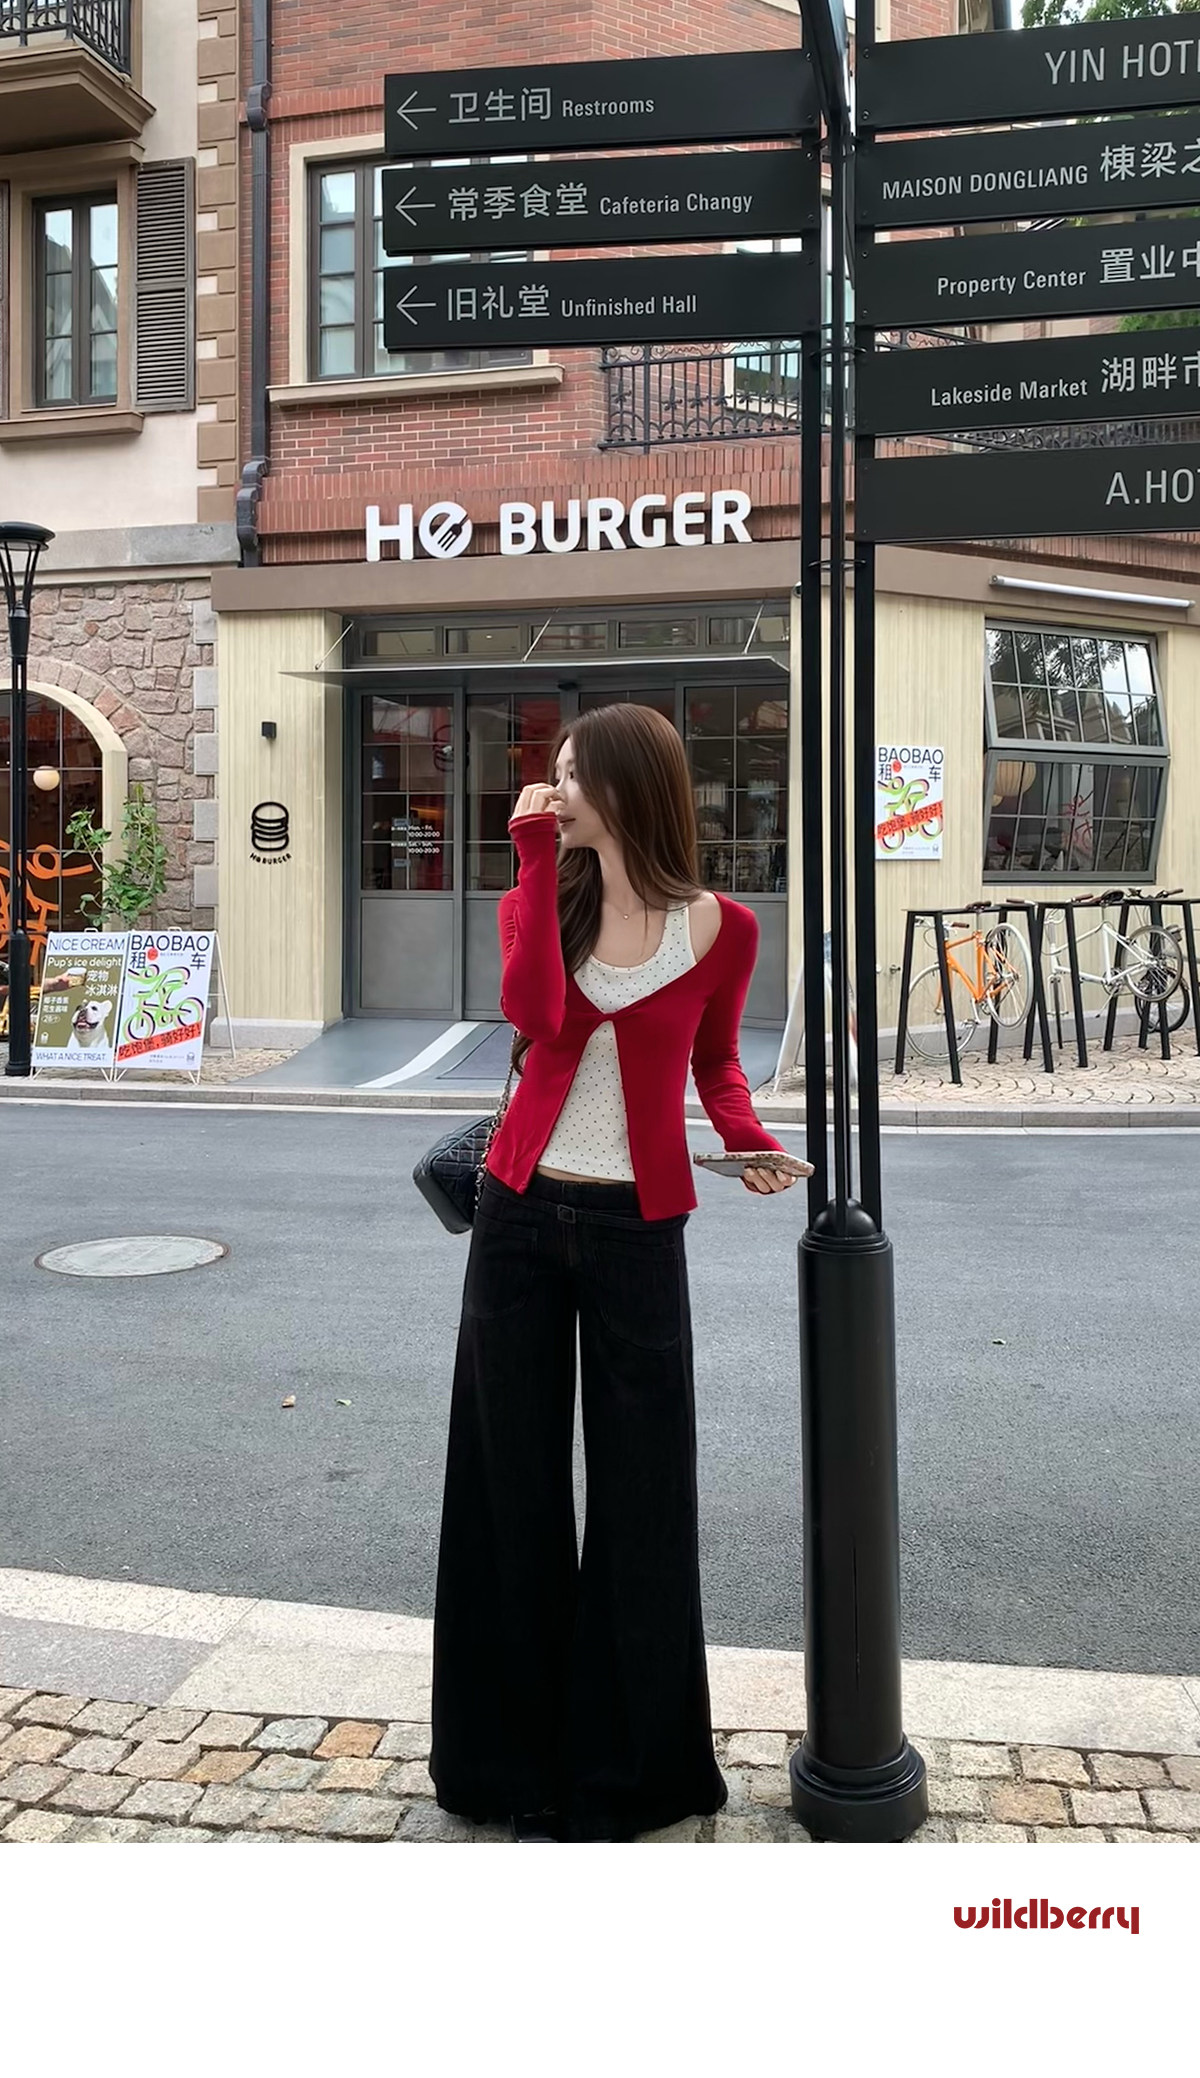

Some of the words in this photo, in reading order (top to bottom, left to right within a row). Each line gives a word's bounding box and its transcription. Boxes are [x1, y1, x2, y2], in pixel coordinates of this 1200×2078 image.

[1044, 47, 1105, 85] YIN
[1122, 39, 1200, 79] HOT
[447, 87, 552, 124] 卫生间
[562, 98, 654, 118] Restrooms
[882, 176, 962, 200] MAISON
[970, 165, 1088, 193] DONGLIANG
[447, 182, 589, 221] 常季食堂
[600, 194, 680, 215] Cafeteria
[686, 193, 753, 214] Changy
[937, 274, 1017, 297] Property
[1023, 270, 1086, 290] Center
[447, 283, 550, 322] 旧礼堂
[561, 297, 655, 318] Unfinished
[662, 294, 697, 314] Hall
[931, 383, 1012, 406] Lakeside
[1019, 379, 1088, 400] Market
[1105, 468, 1200, 505] A.HO
[499, 490, 752, 556] BURGER
[878, 747, 944, 765] BAOBAO
[878, 763, 892, 781] 租
[929, 765, 941, 782] 车
[262, 853, 292, 865] BURGER
[49, 938, 78, 951] NICE
[80, 938, 125, 951] CREAM
[131, 935, 210, 952] BAOBAO
[47, 957, 73, 968] Pup's
[74, 957, 88, 967] ice
[89, 957, 122, 969] delight
[130, 951, 146, 969] 租
[190, 952, 206, 970] 车
[86, 970, 109, 982] 宠物
[85, 983, 118, 997] 冰淇淋
[36, 1053, 58, 1061] WHAT
[58, 1053, 64, 1061] A
[64, 1052, 83, 1061] NICE
